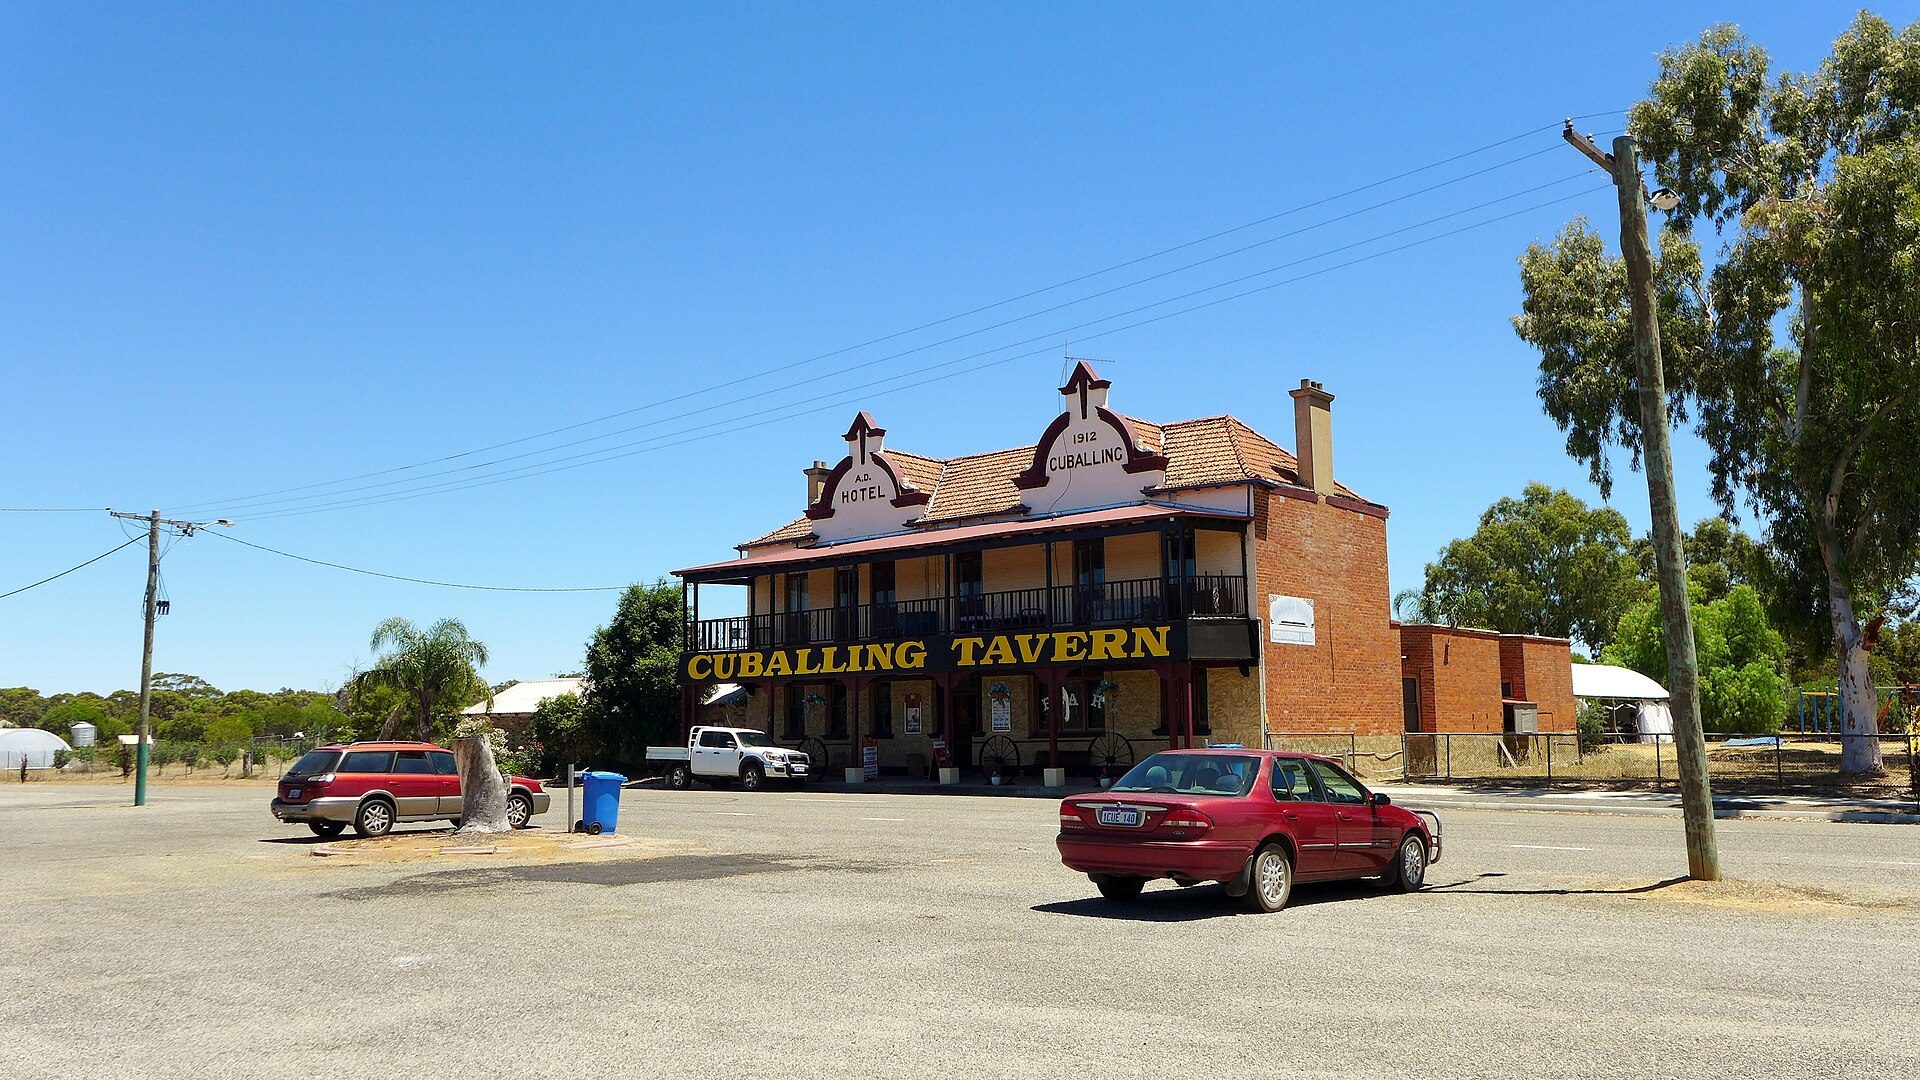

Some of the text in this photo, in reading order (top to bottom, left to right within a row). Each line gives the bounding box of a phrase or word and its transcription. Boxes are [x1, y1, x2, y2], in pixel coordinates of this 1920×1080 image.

[1073, 431, 1097, 444] 1912
[1049, 446, 1123, 472] CUBALLING
[855, 473, 872, 483] A.D.
[841, 485, 886, 504] HOTEL
[687, 625, 1171, 680] CUBALLING TAVERN
